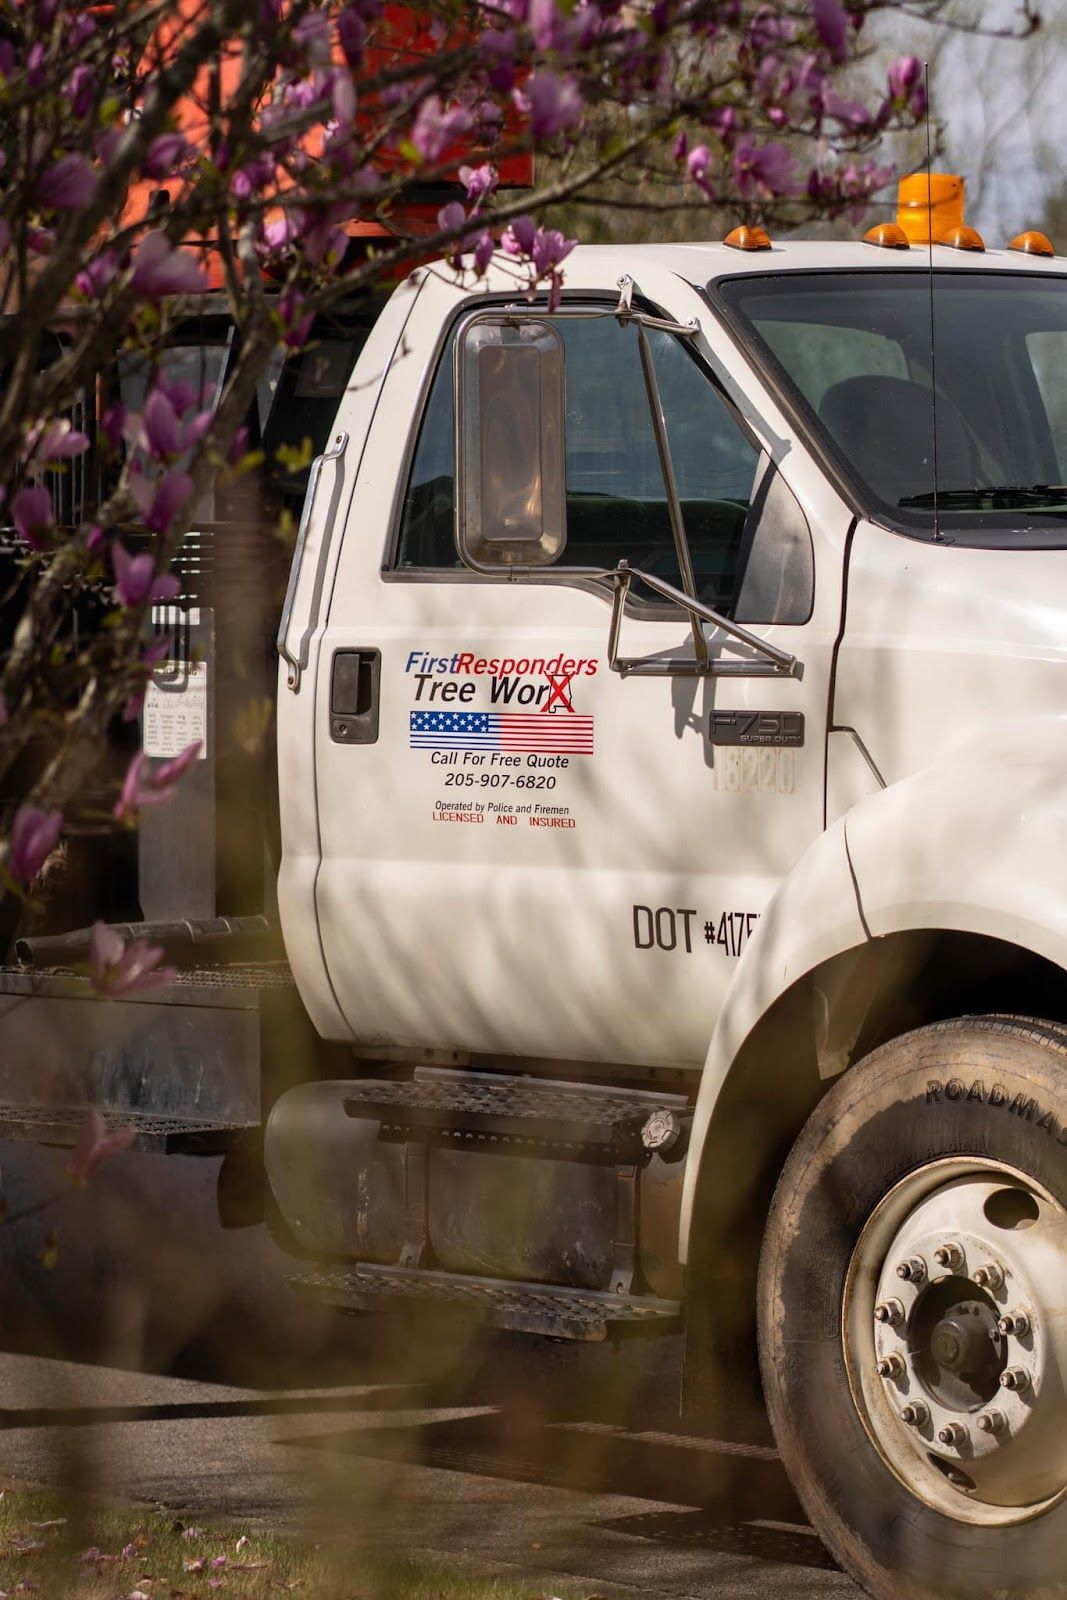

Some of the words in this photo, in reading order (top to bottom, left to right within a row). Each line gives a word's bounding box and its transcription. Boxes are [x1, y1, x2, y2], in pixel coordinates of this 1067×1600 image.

[414, 674, 476, 702] Tree
[740, 734, 772, 743] SUPER
[774, 735, 801, 743] DUTY
[431, 751, 457, 765] Call
[463, 752, 486, 766] For
[490, 753, 521, 767] Free
[527, 754, 569, 768] Quote
[444, 773, 556, 789] 205-907-6820
[435, 800, 473, 812] Operated
[475, 802, 485, 813] by
[487, 802, 513, 813] Police
[515, 804, 531, 814] and
[534, 804, 570, 815] Firemen
[432, 812, 484, 823] LICENSED
[496, 815, 518, 825] AND
[529, 816, 576, 828] INSURED
[633, 905, 697, 953] DOT
